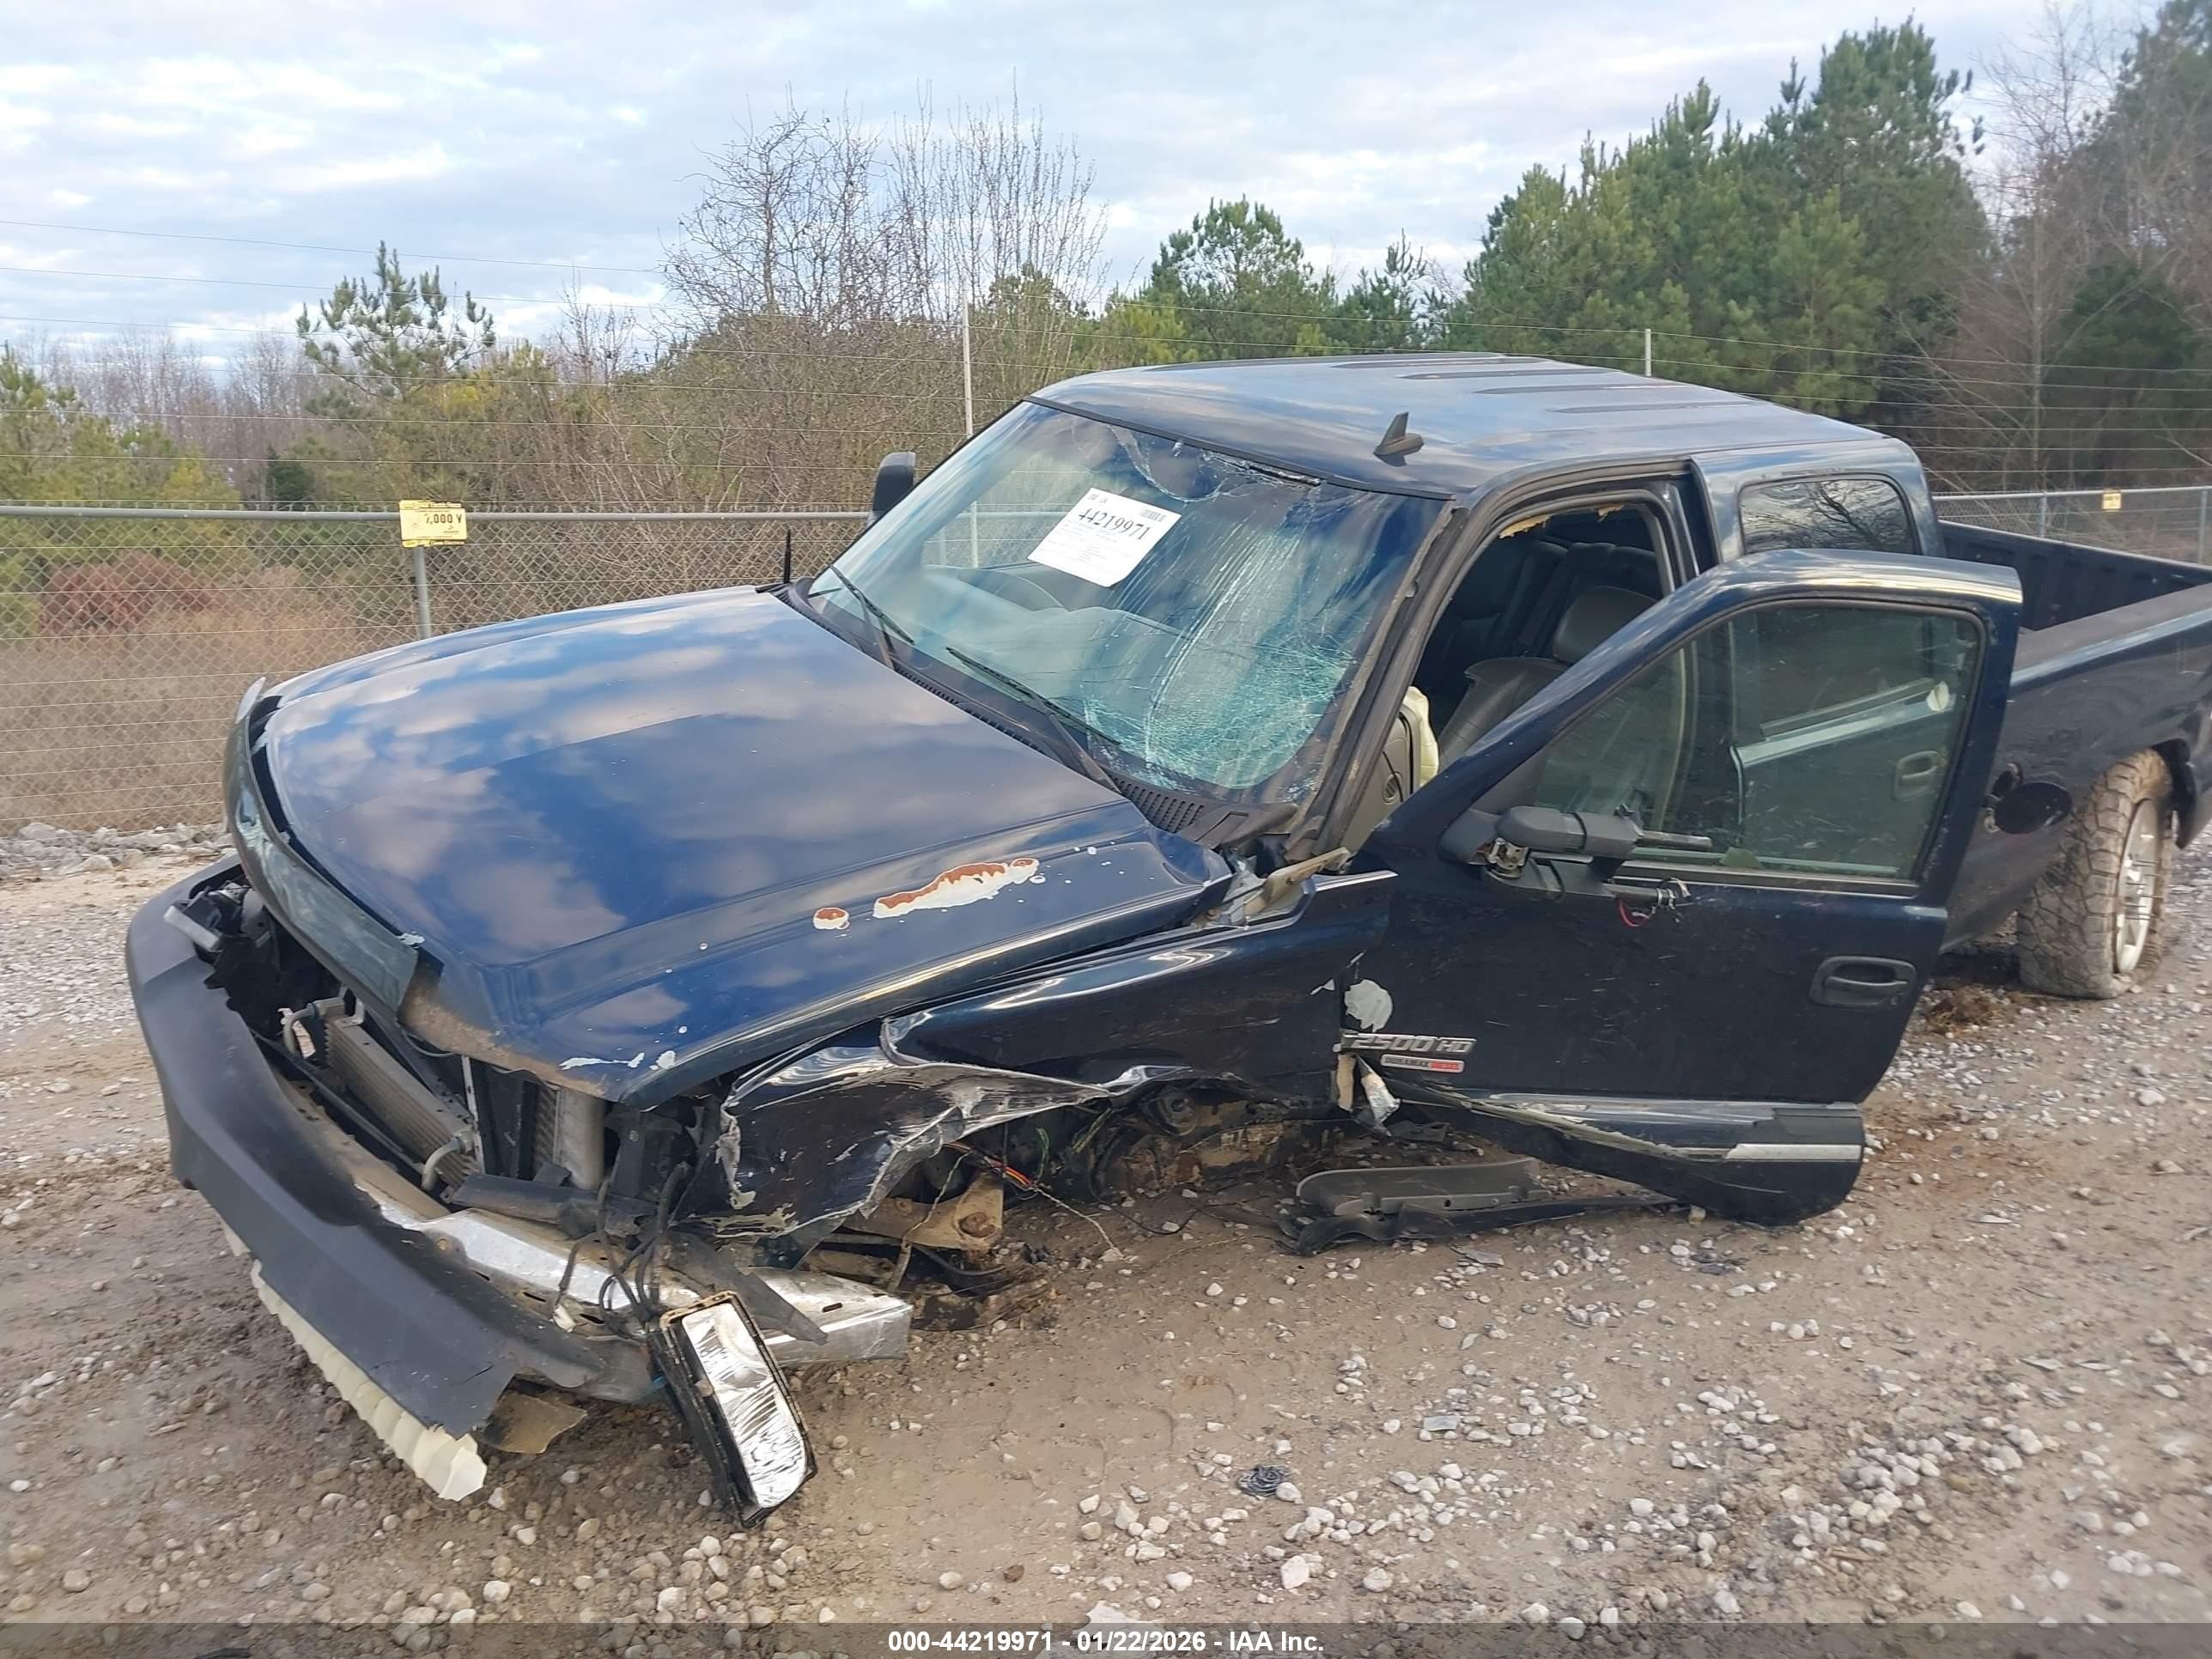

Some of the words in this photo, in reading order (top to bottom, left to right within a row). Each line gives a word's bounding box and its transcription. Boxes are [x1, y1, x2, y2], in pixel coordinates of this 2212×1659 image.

[1079, 508, 1151, 540] 44219971
[1351, 1034, 1432, 1053] 2500
[1436, 1037, 1476, 1054] HD
